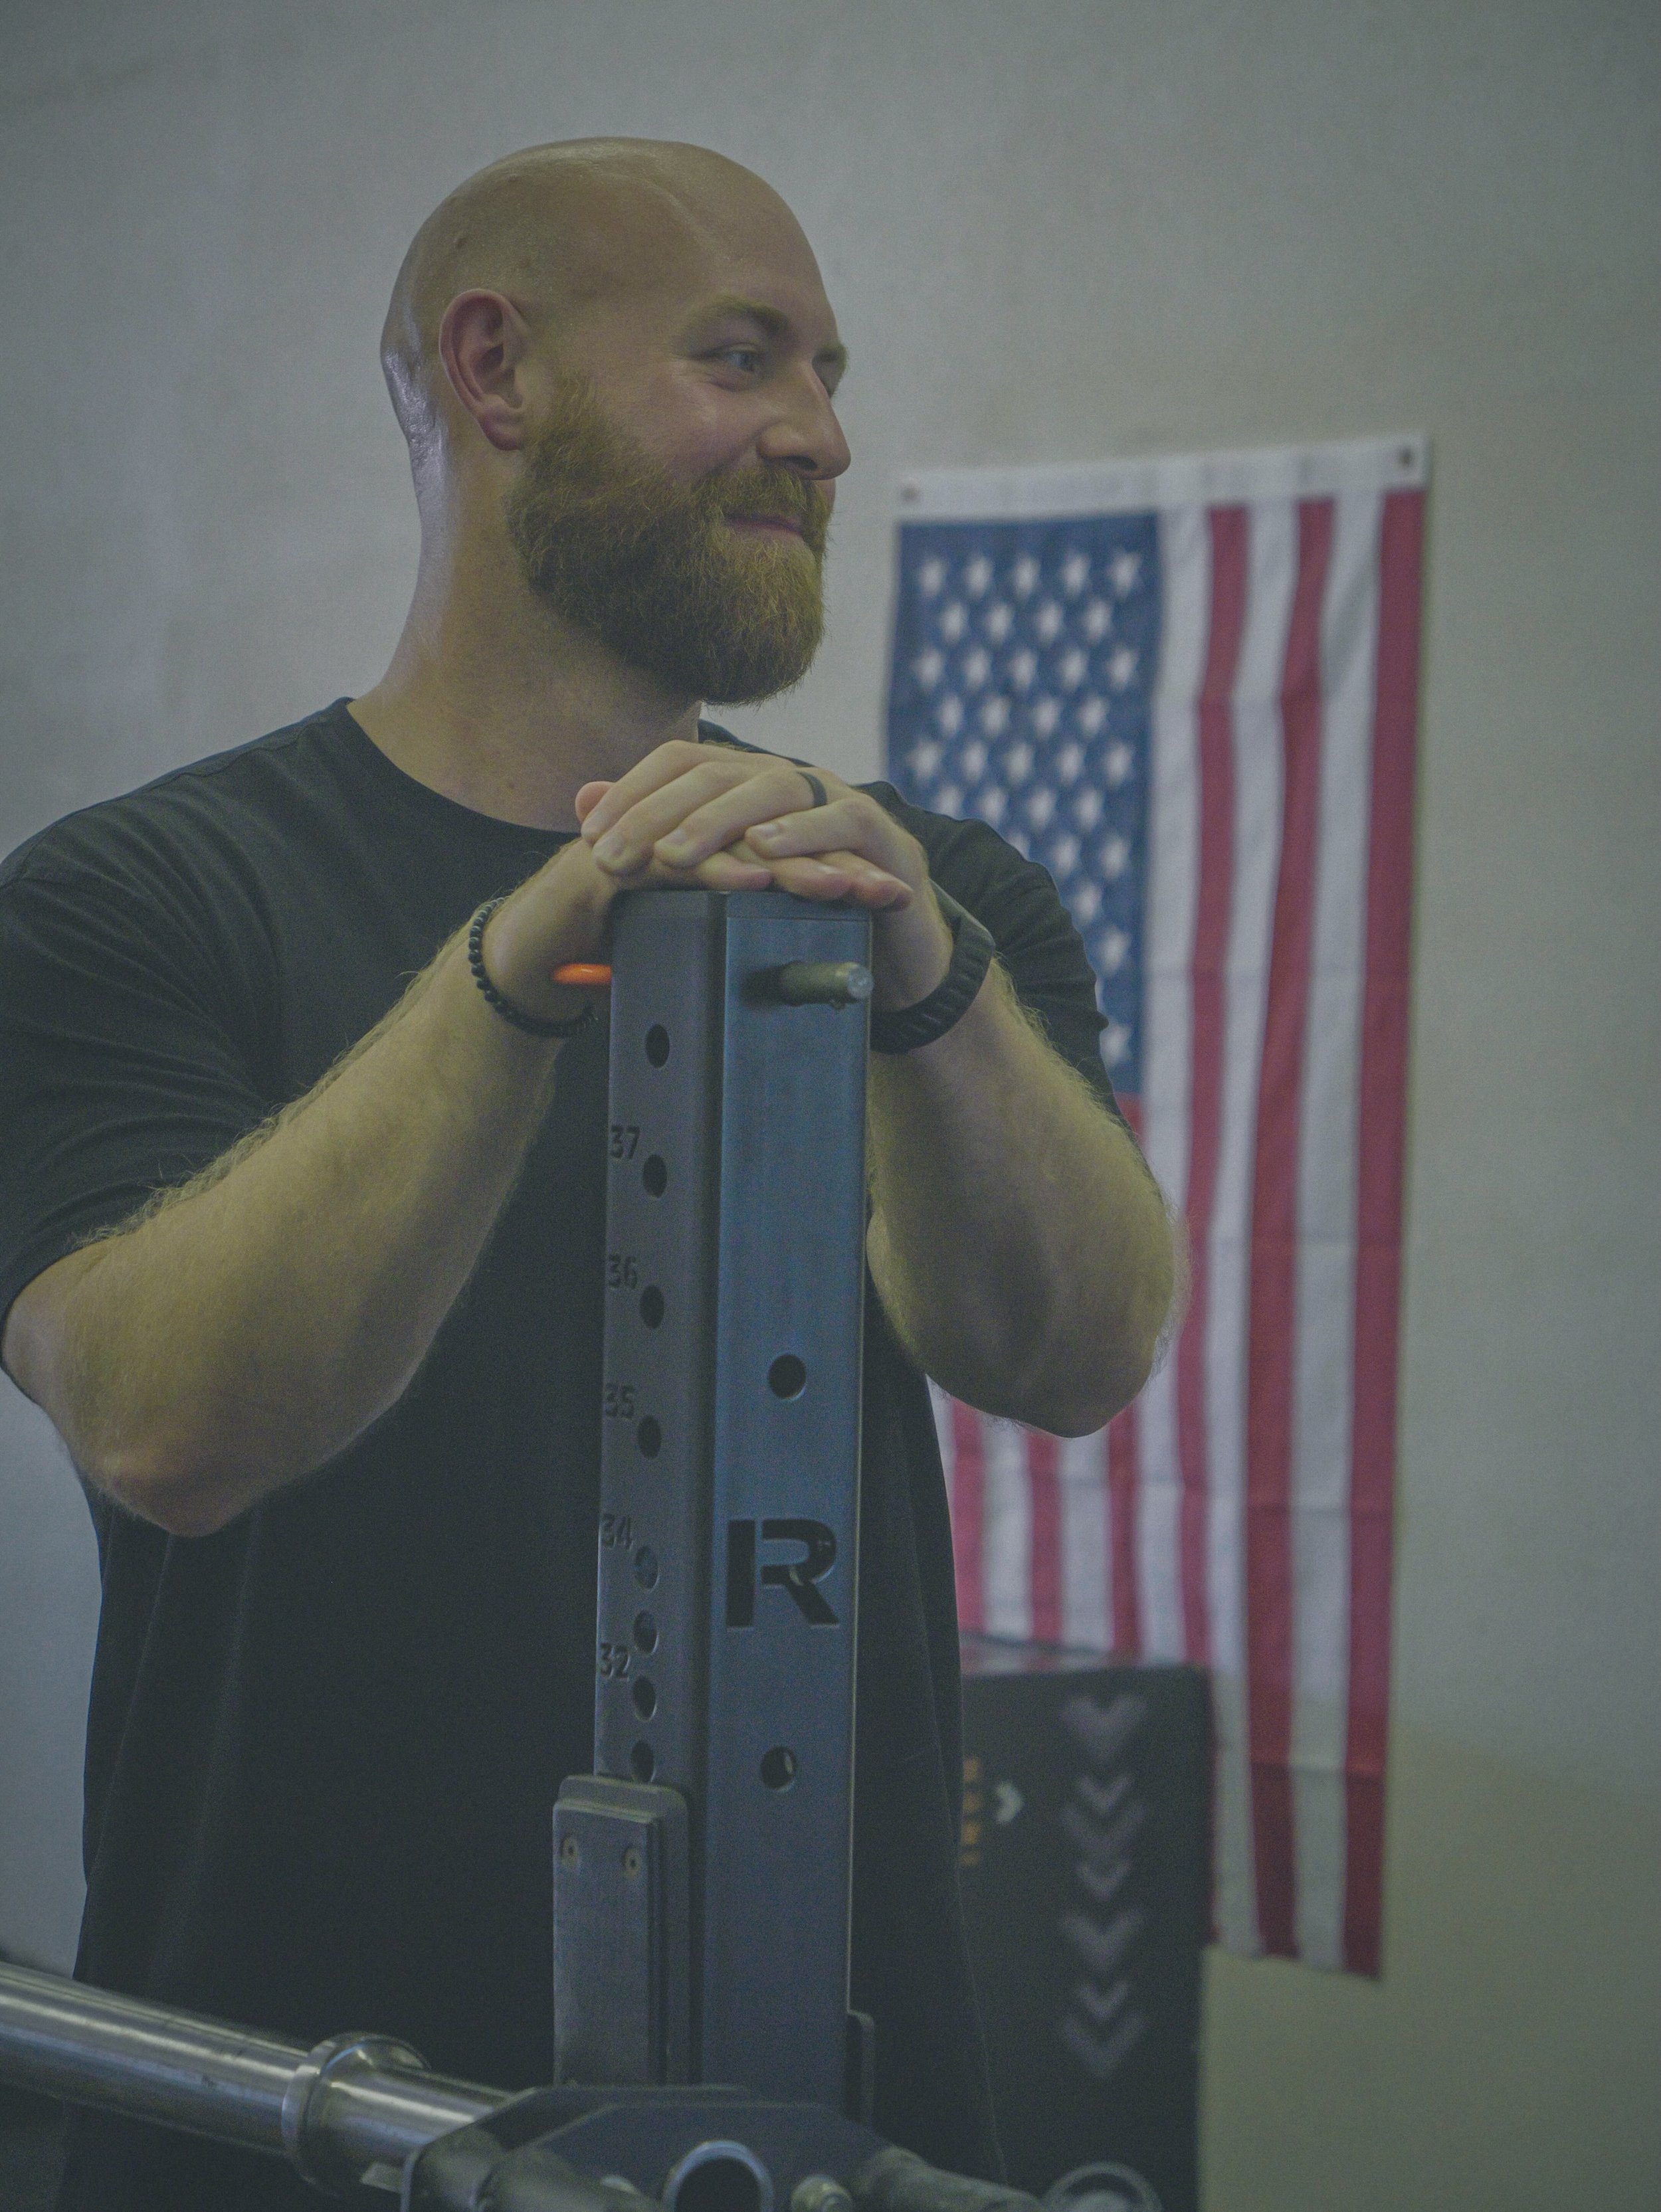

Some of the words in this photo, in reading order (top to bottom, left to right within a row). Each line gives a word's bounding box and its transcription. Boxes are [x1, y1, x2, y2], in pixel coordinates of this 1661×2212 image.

[611, 1125, 640, 1160] 37
[609, 1255, 638, 1290] 36
[605, 1384, 635, 1420] 35
[601, 1514, 633, 1550] 34
[727, 1519, 840, 1626] R
[601, 1642, 631, 1679] 32
